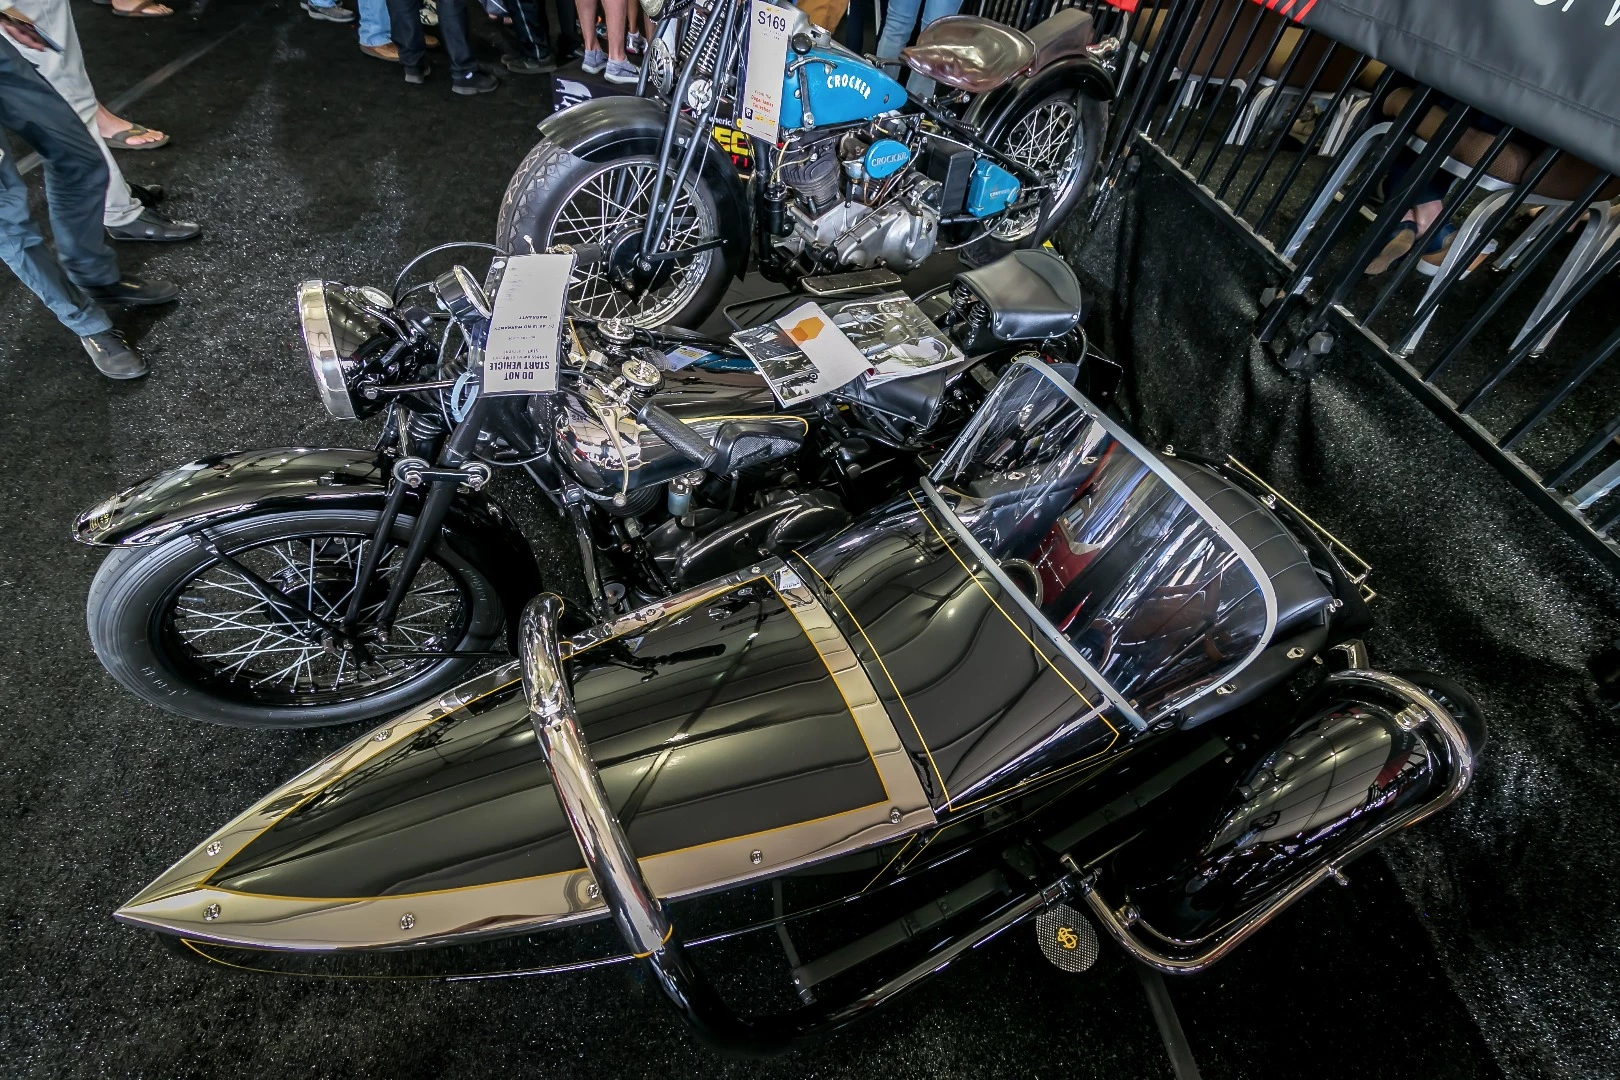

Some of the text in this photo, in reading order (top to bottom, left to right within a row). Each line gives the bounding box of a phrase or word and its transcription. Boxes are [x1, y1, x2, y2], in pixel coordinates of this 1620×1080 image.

[757, 11, 786, 32] S169
[827, 74, 871, 99] CROCKER
[871, 151, 908, 167] CROCKER
[489, 361, 550, 371] START VEHICLE
[503, 371, 534, 381] DO NOT
